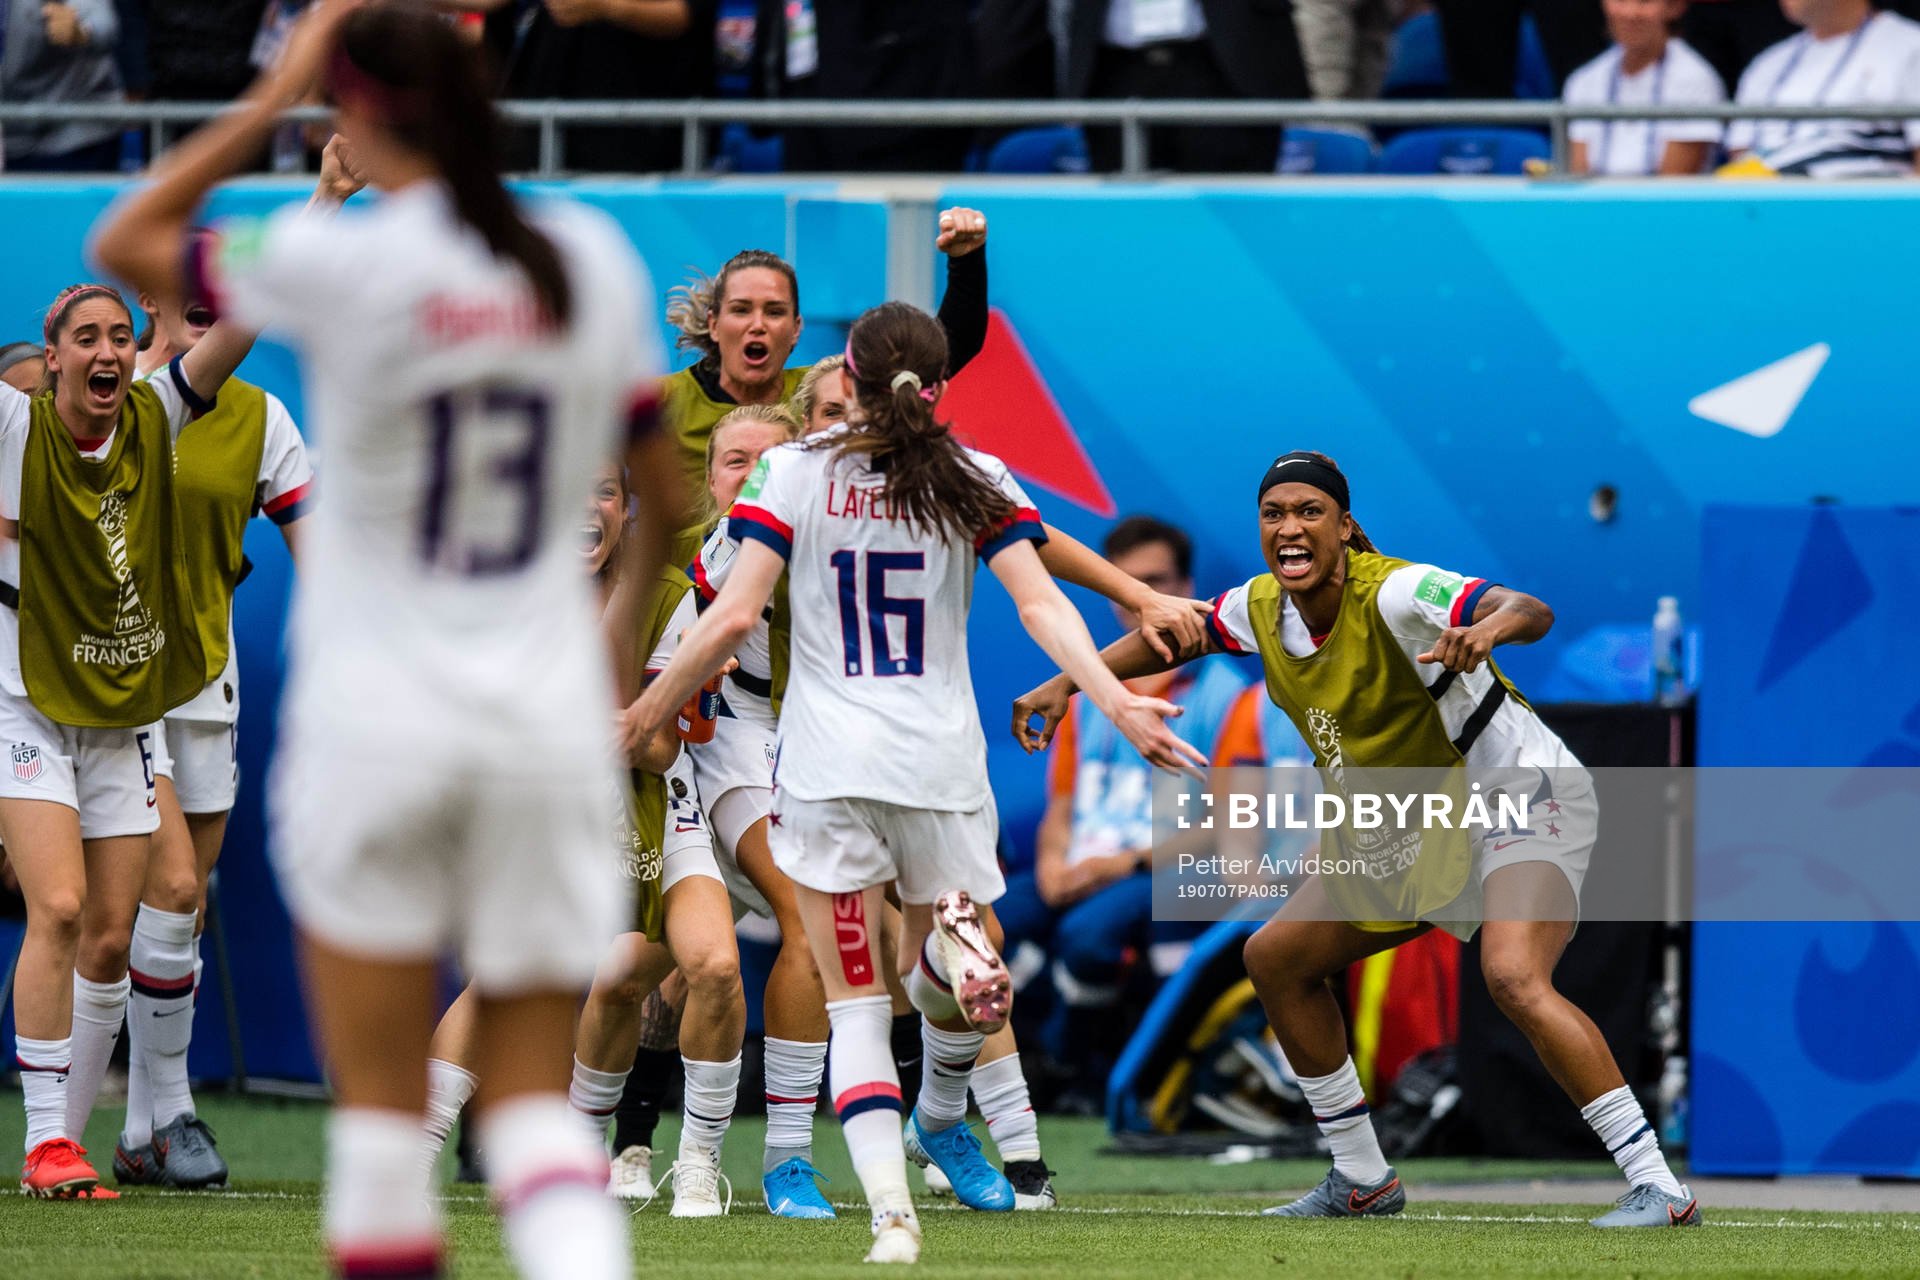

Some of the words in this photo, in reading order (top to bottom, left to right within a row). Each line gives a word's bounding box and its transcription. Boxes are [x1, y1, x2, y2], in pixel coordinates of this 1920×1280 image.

[422, 387, 551, 575] 13
[119, 614, 142, 630] FIFA
[830, 550, 926, 678] 16
[81, 633, 127, 648] WOMEN'S
[73, 643, 151, 666] FRANCE
[14, 748, 37, 764] USA
[1367, 841, 1400, 861] WORLD
[1401, 831, 1421, 846] CUP
